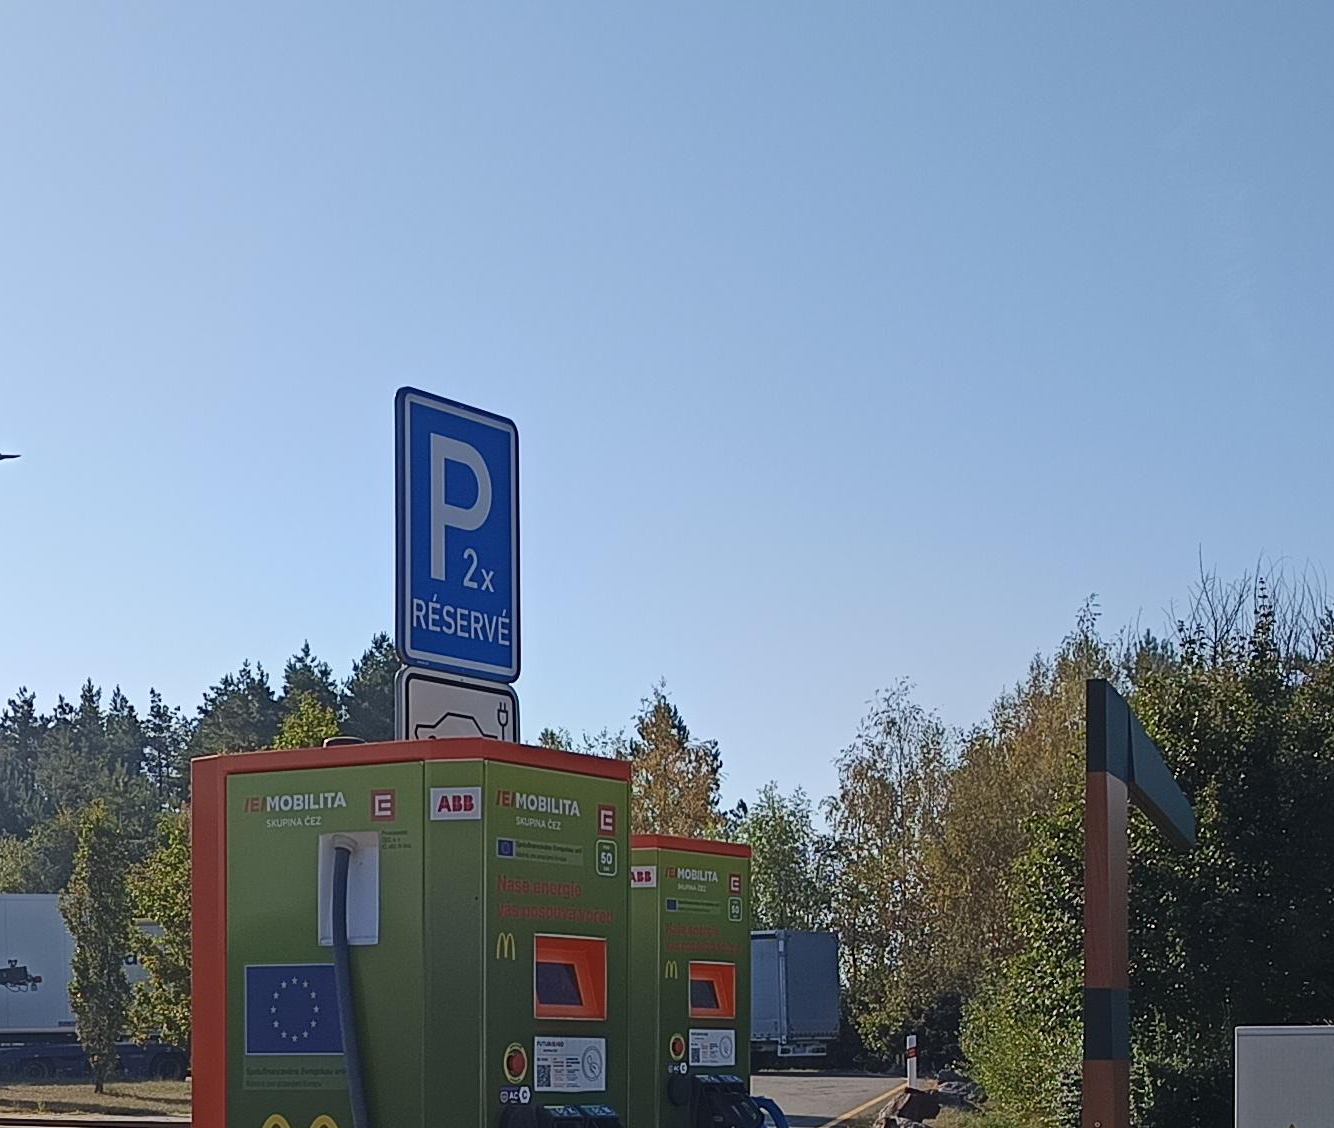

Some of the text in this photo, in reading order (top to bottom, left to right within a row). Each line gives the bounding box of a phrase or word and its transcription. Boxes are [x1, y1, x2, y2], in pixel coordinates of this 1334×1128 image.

[430, 432, 492, 581] P
[463, 547, 494, 593] 2x
[412, 593, 511, 647] RÉSERVÉ
[437, 794, 475, 813] ABB
[266, 815, 323, 829] SKUPINA ČEZ
[515, 817, 562, 831] SKUPINA ČEZ
[600, 851, 614, 865] 50
[496, 874, 583, 900] Naše energie
[508, 1091, 519, 1100] AC
